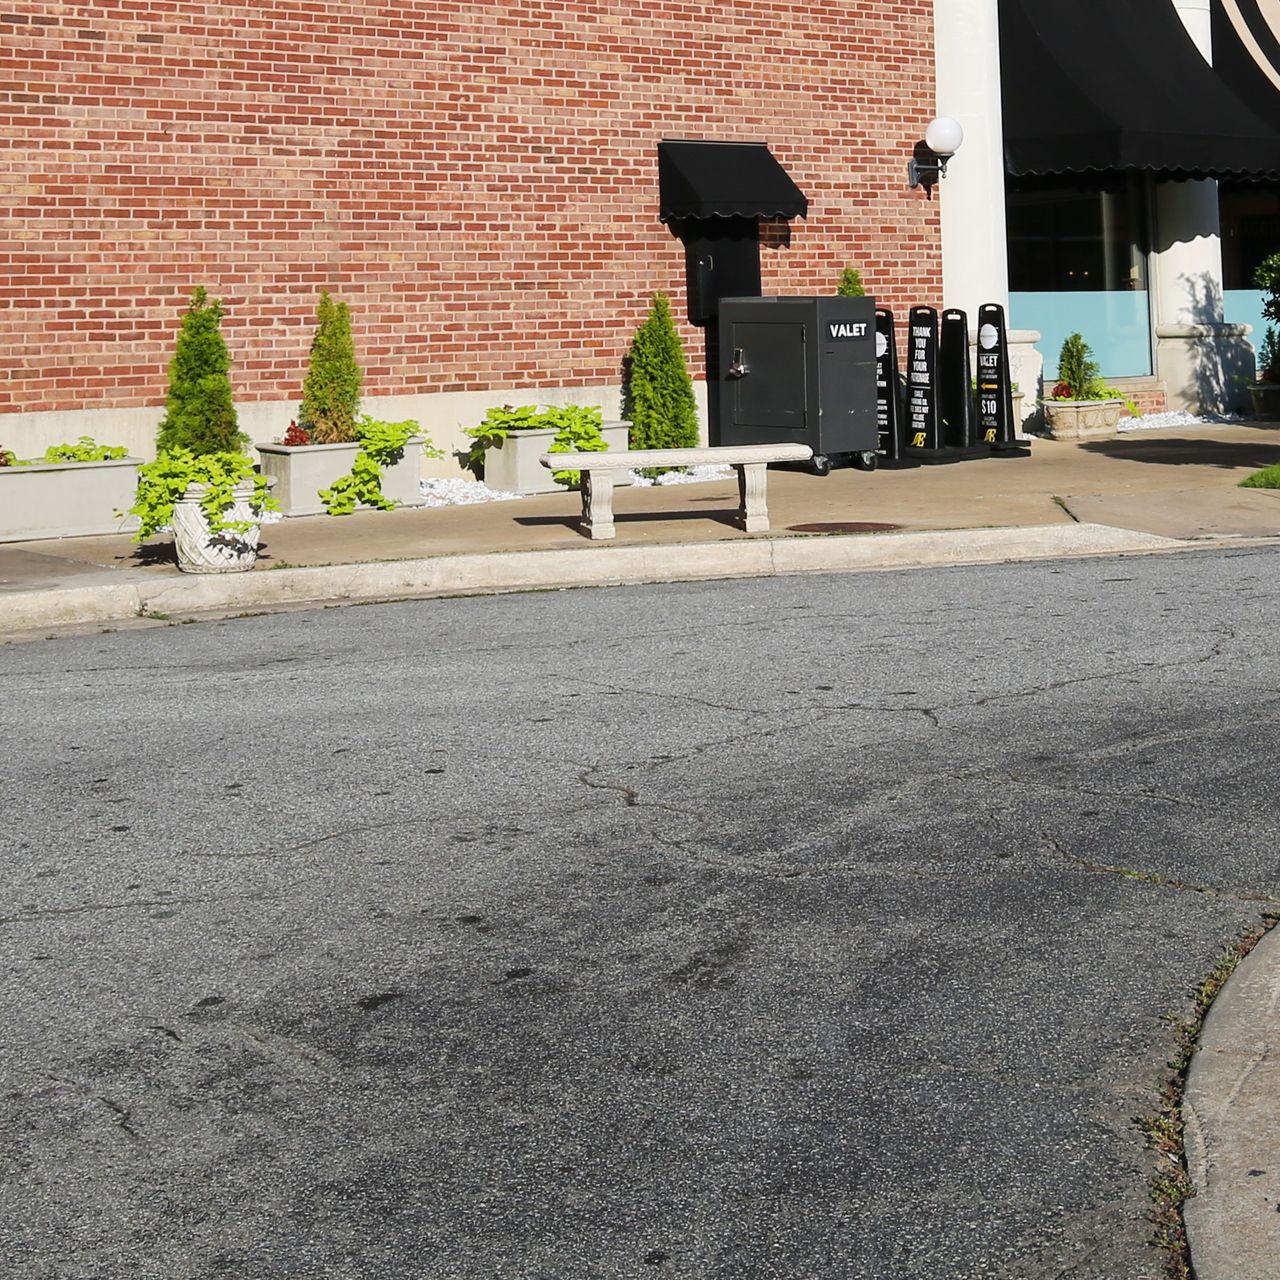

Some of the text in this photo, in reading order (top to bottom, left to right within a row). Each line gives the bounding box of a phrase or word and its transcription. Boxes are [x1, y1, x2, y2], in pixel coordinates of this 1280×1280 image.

[829, 322, 868, 338] VALET
[912, 326, 932, 338] THANK
[915, 338, 927, 349] YOU
[914, 349, 926, 360] FOR
[912, 360, 928, 372] YOUR
[979, 355, 999, 367] VALET
[981, 399, 997, 415] $10
